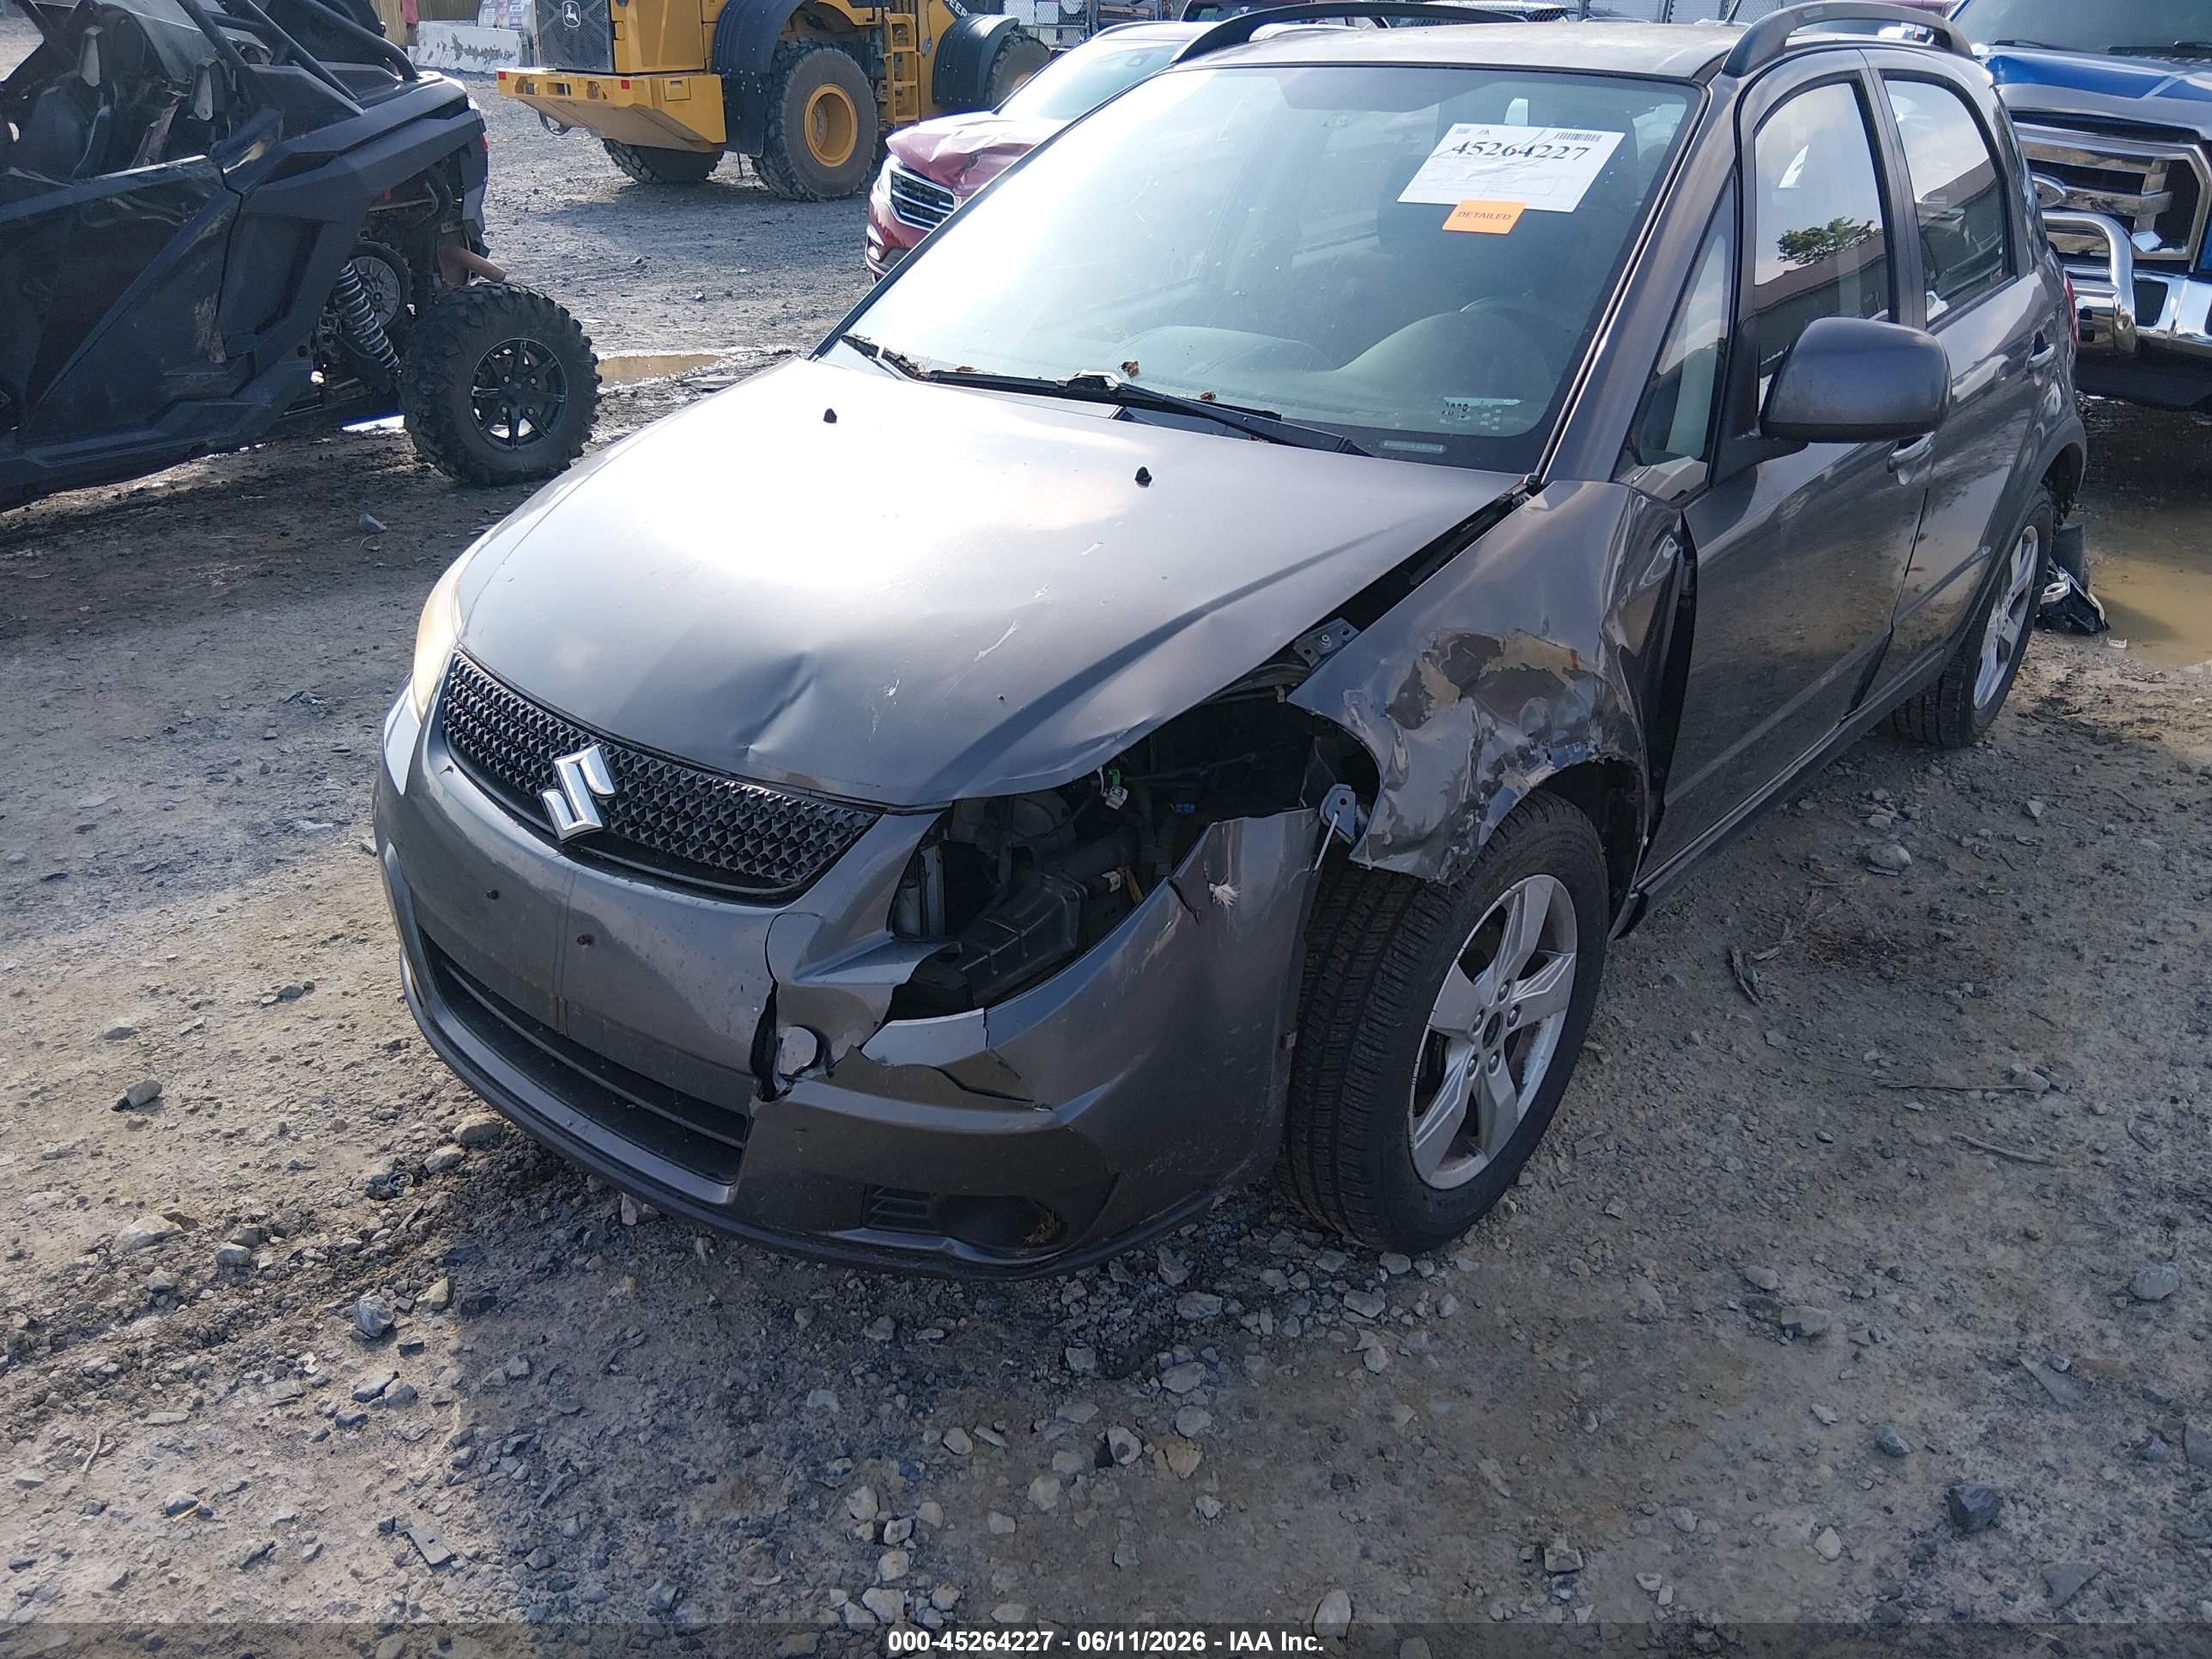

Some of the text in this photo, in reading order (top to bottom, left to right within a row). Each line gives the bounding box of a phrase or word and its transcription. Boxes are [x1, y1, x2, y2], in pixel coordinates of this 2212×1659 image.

[945, 0, 969, 17] EER
[1452, 141, 1589, 161] 45264227
[1456, 210, 1513, 222] DETAILED
